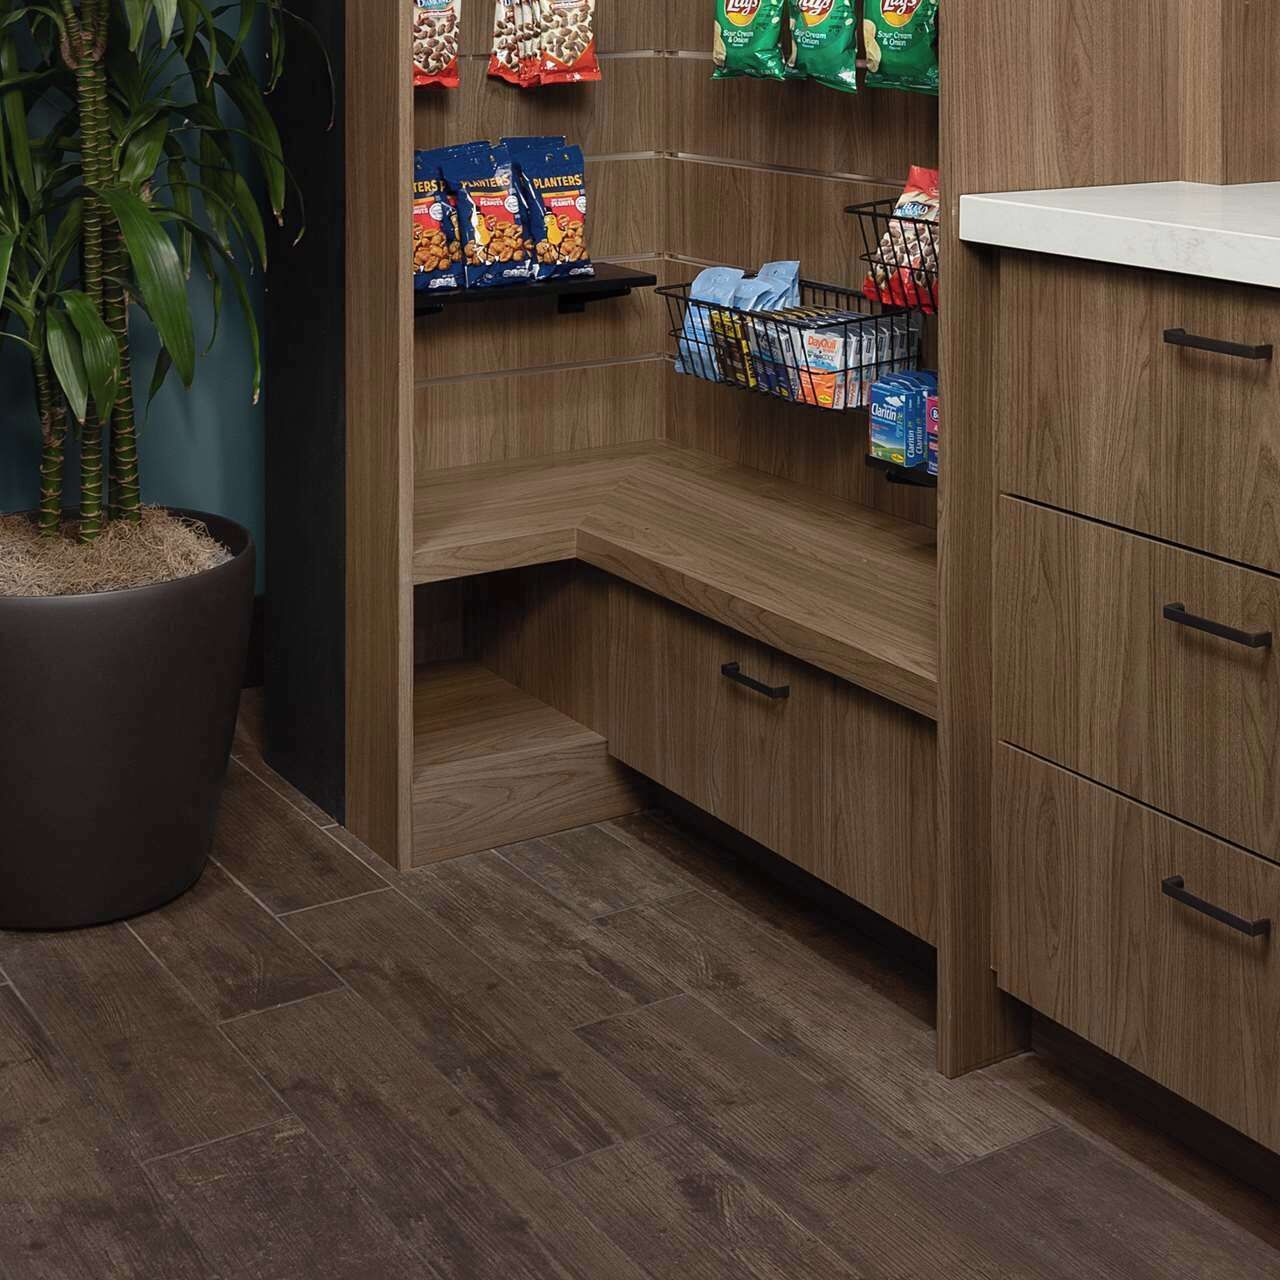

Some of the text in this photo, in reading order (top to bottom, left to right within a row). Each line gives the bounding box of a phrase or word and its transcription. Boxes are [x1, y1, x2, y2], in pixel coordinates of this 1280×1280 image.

[533, 173, 583, 188] PLANTERS
[871, 403, 898, 421] Claritin
[906, 430, 915, 458] Claritin
